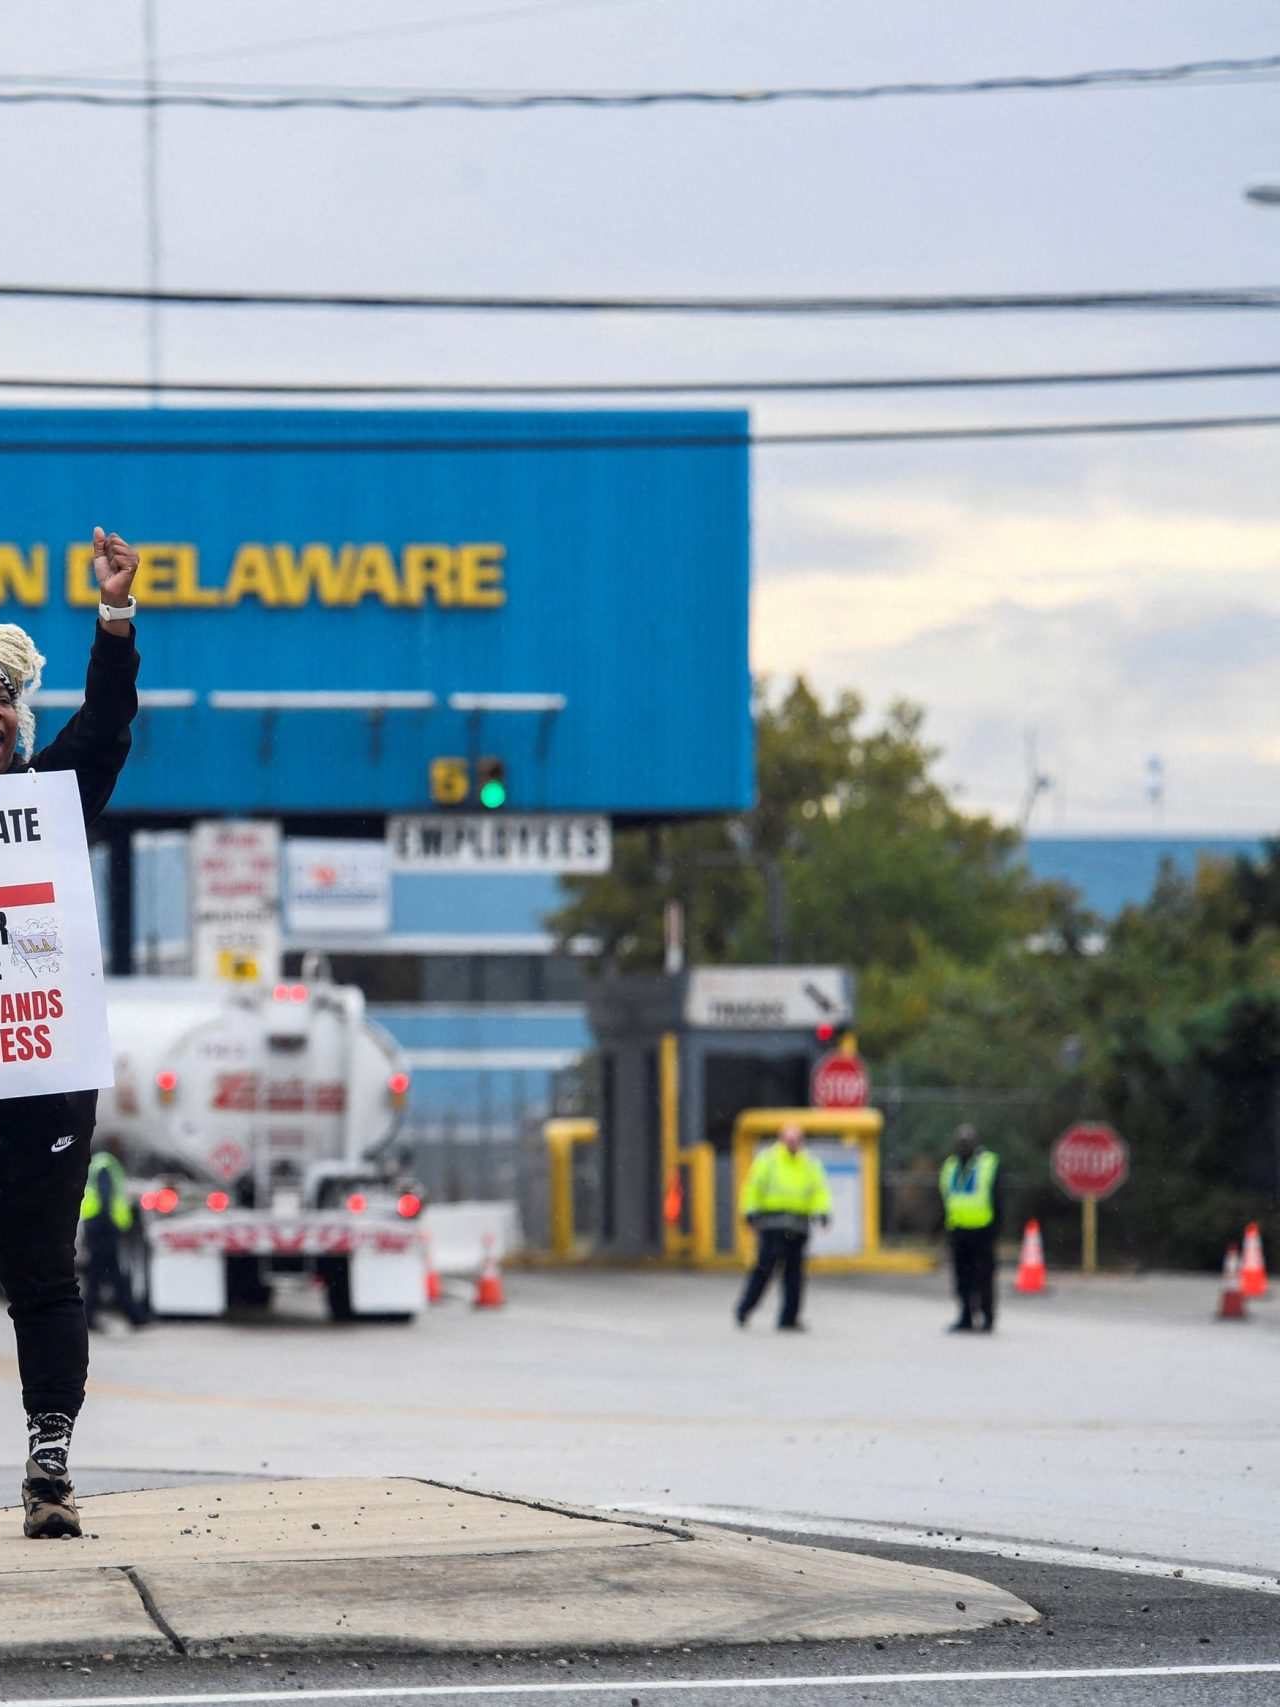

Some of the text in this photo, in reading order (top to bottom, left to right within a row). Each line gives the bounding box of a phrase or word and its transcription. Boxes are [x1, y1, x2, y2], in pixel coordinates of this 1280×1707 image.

[395, 816, 600, 860] EMPLOYEES
[813, 1070, 869, 1105] STOP
[56, 1135, 74, 1146] NIKE
[1056, 1144, 1123, 1175] STOP
